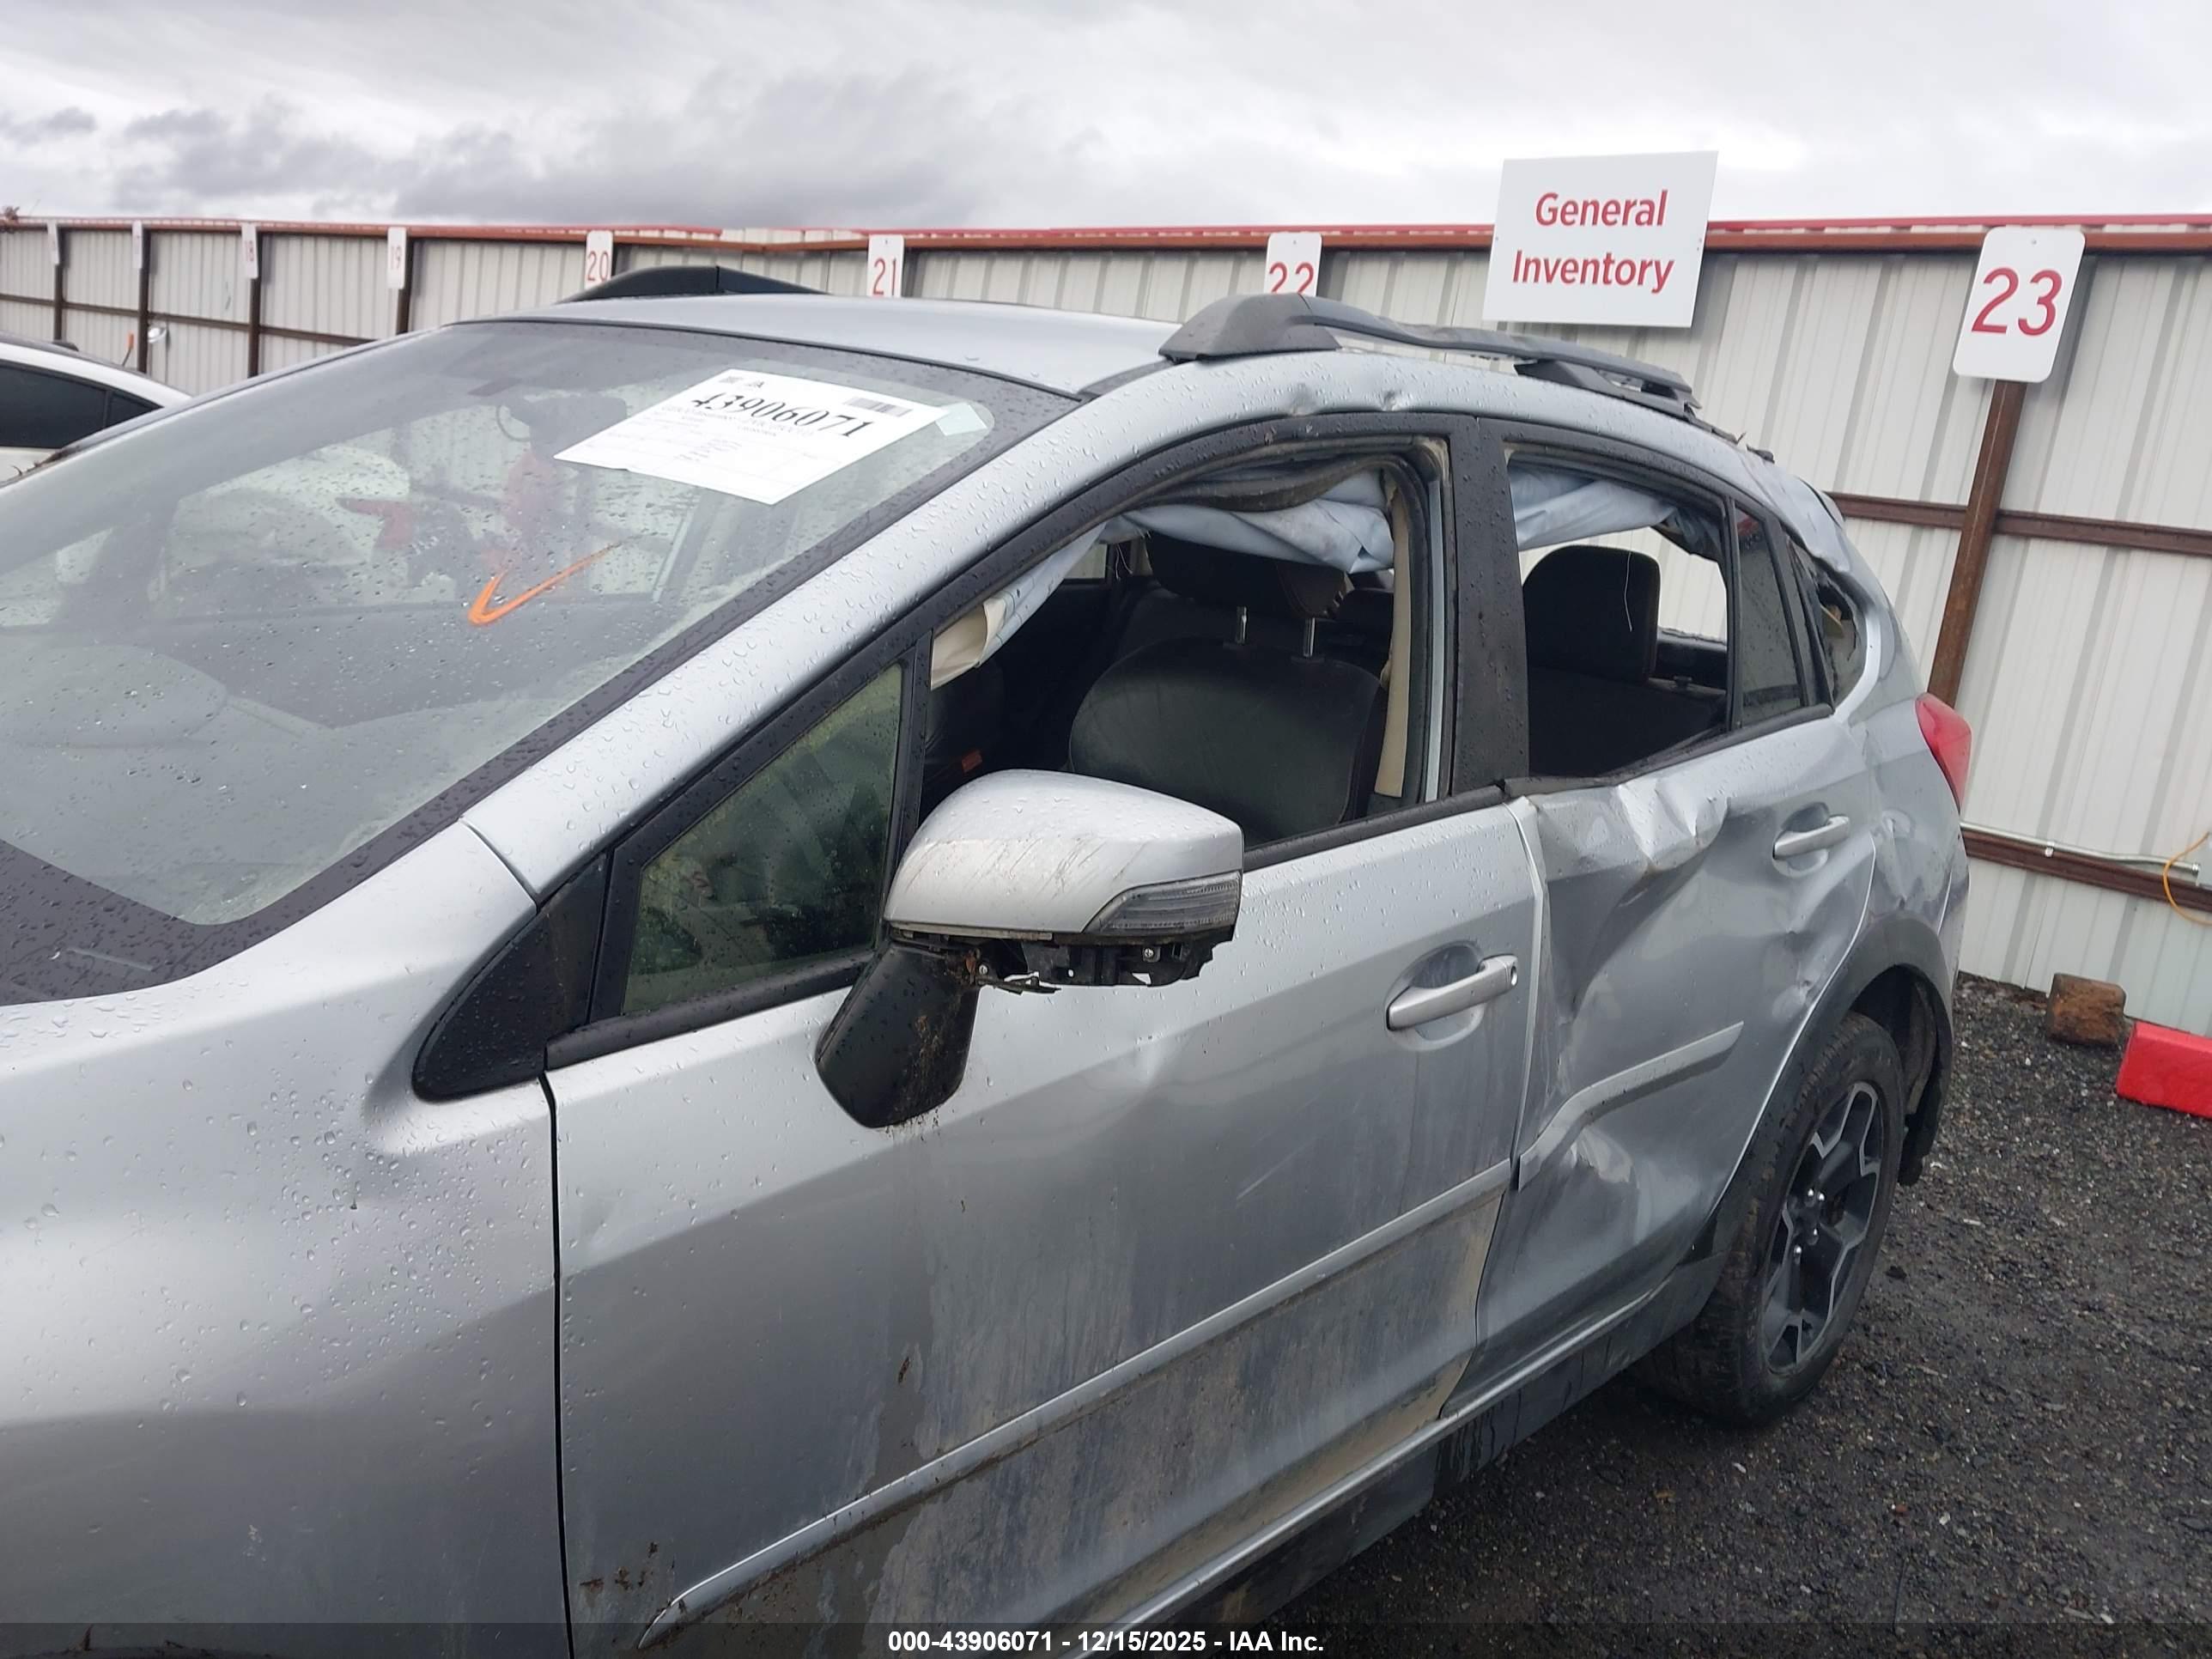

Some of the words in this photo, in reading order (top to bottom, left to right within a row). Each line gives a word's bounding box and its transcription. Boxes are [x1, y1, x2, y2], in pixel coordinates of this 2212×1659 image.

[1534, 189, 1668, 228] General
[587, 250, 609, 283] 20
[872, 257, 896, 296] 21
[1268, 260, 1315, 295] 22
[1512, 250, 1674, 295] Inventory
[1970, 265, 2063, 337] 23
[691, 392, 874, 437] 43906071
